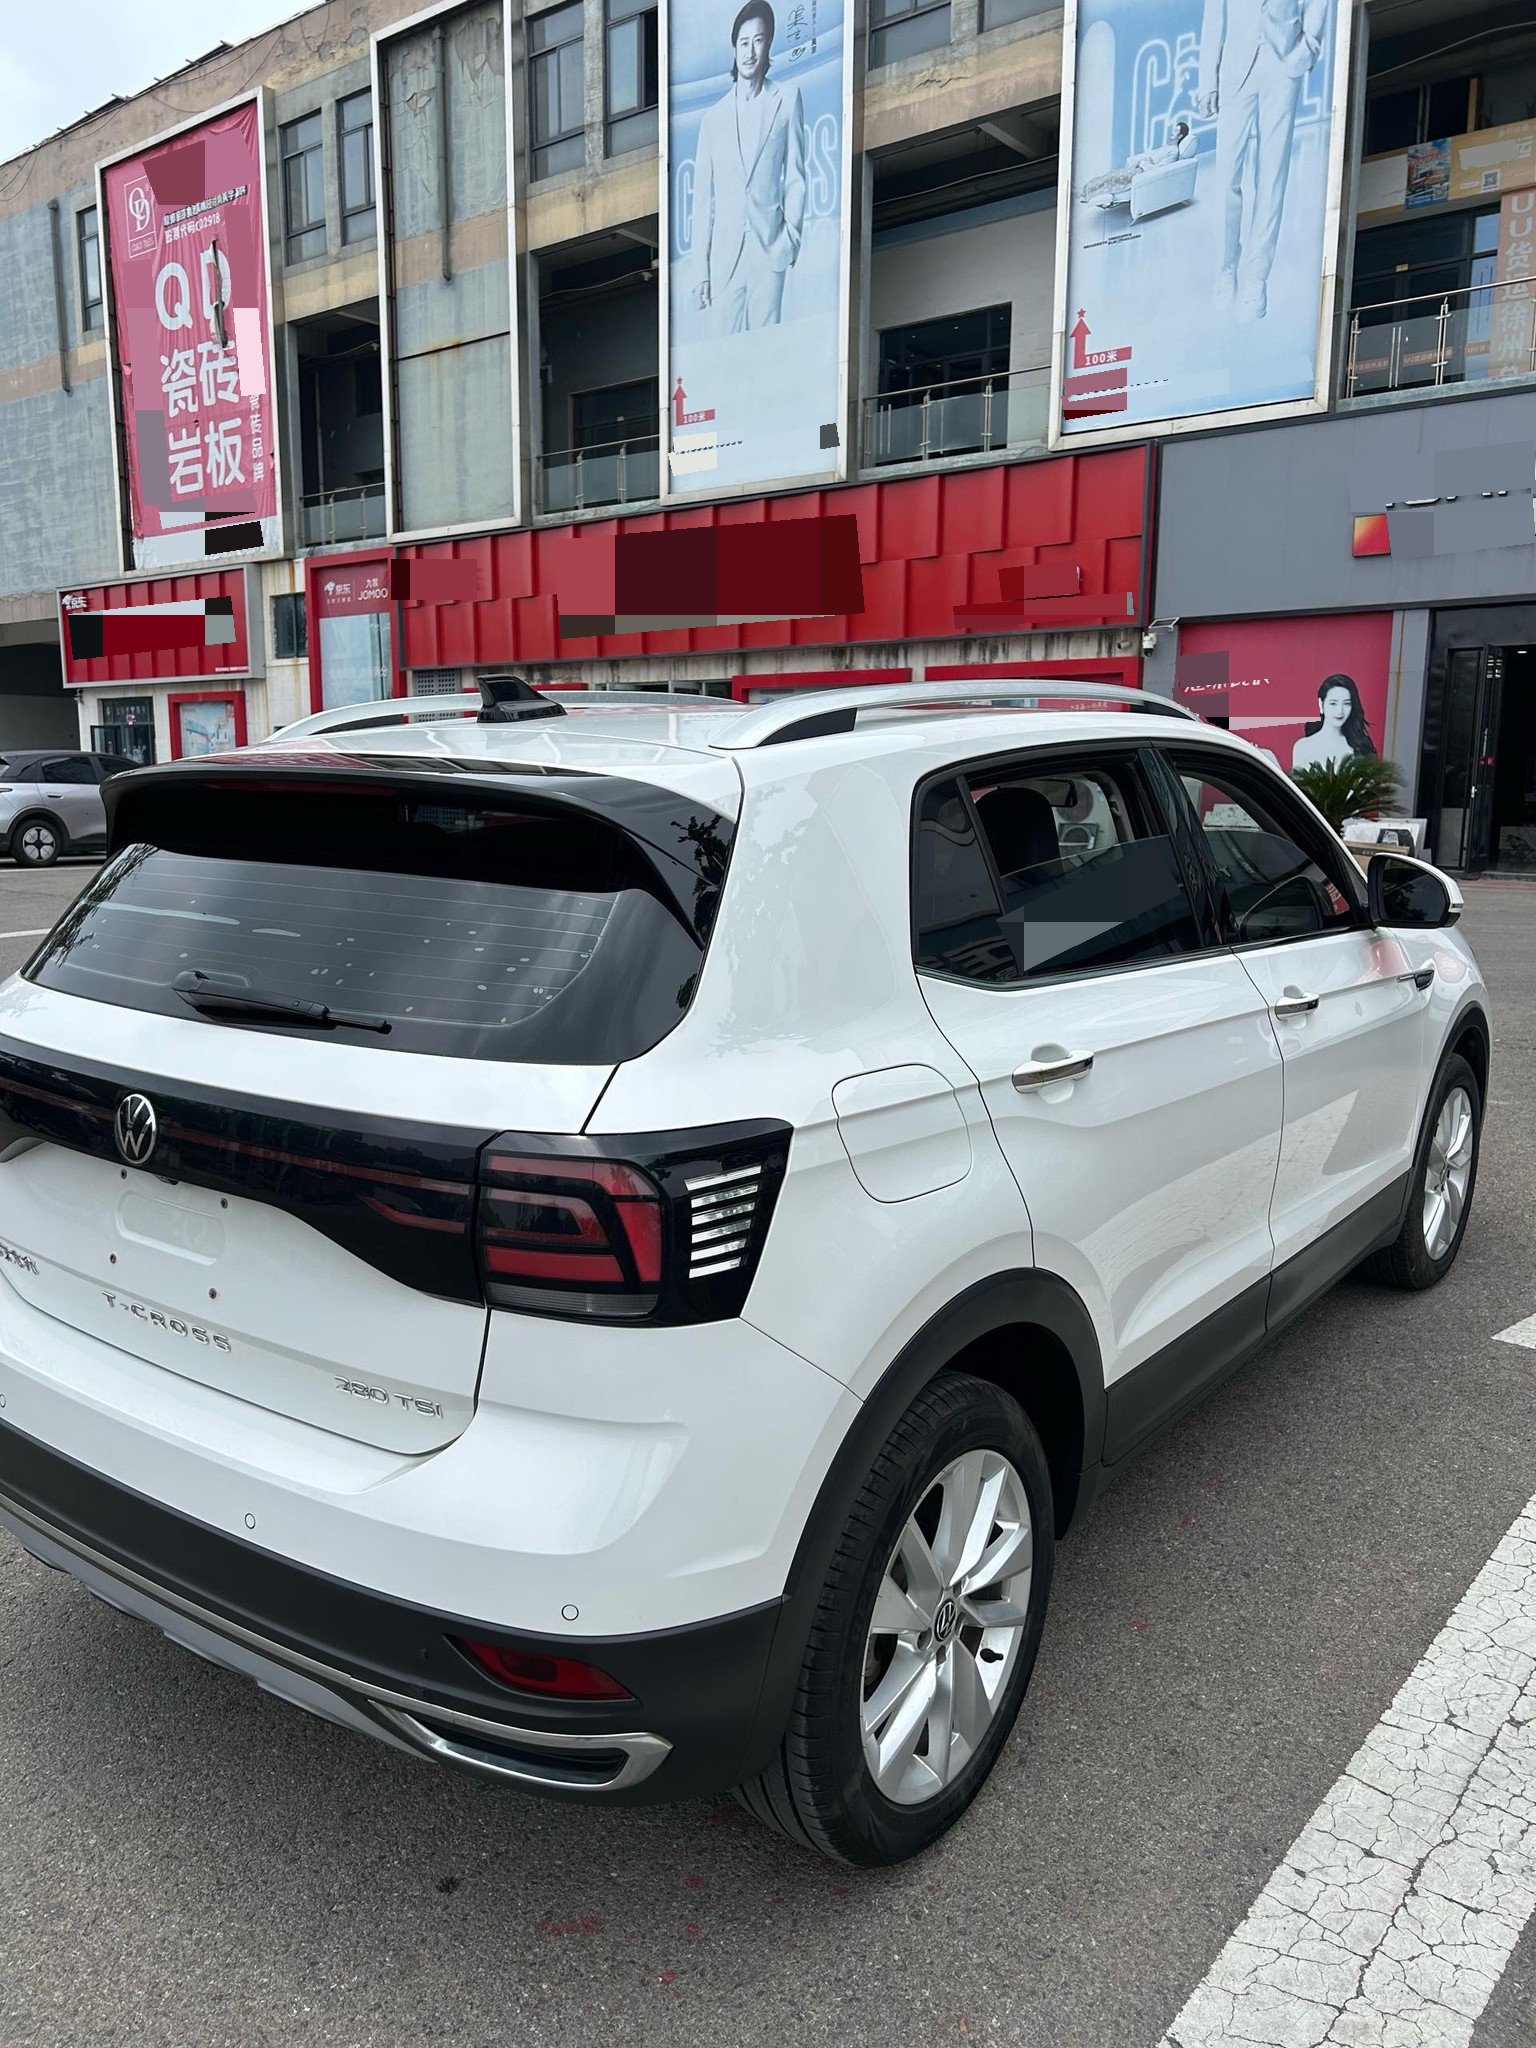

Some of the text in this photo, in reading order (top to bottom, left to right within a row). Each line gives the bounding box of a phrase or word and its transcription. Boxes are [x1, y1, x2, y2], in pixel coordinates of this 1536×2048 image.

[160, 339, 240, 418] 瓷砖
[1085, 351, 1118, 367] 100米
[683, 411, 707, 424] 100米
[168, 417, 246, 495] 岩板
[358, 588, 389, 600] JOMOO
[101, 1290, 232, 1353] T-CROSS
[334, 1375, 443, 1420] 280 TSI
